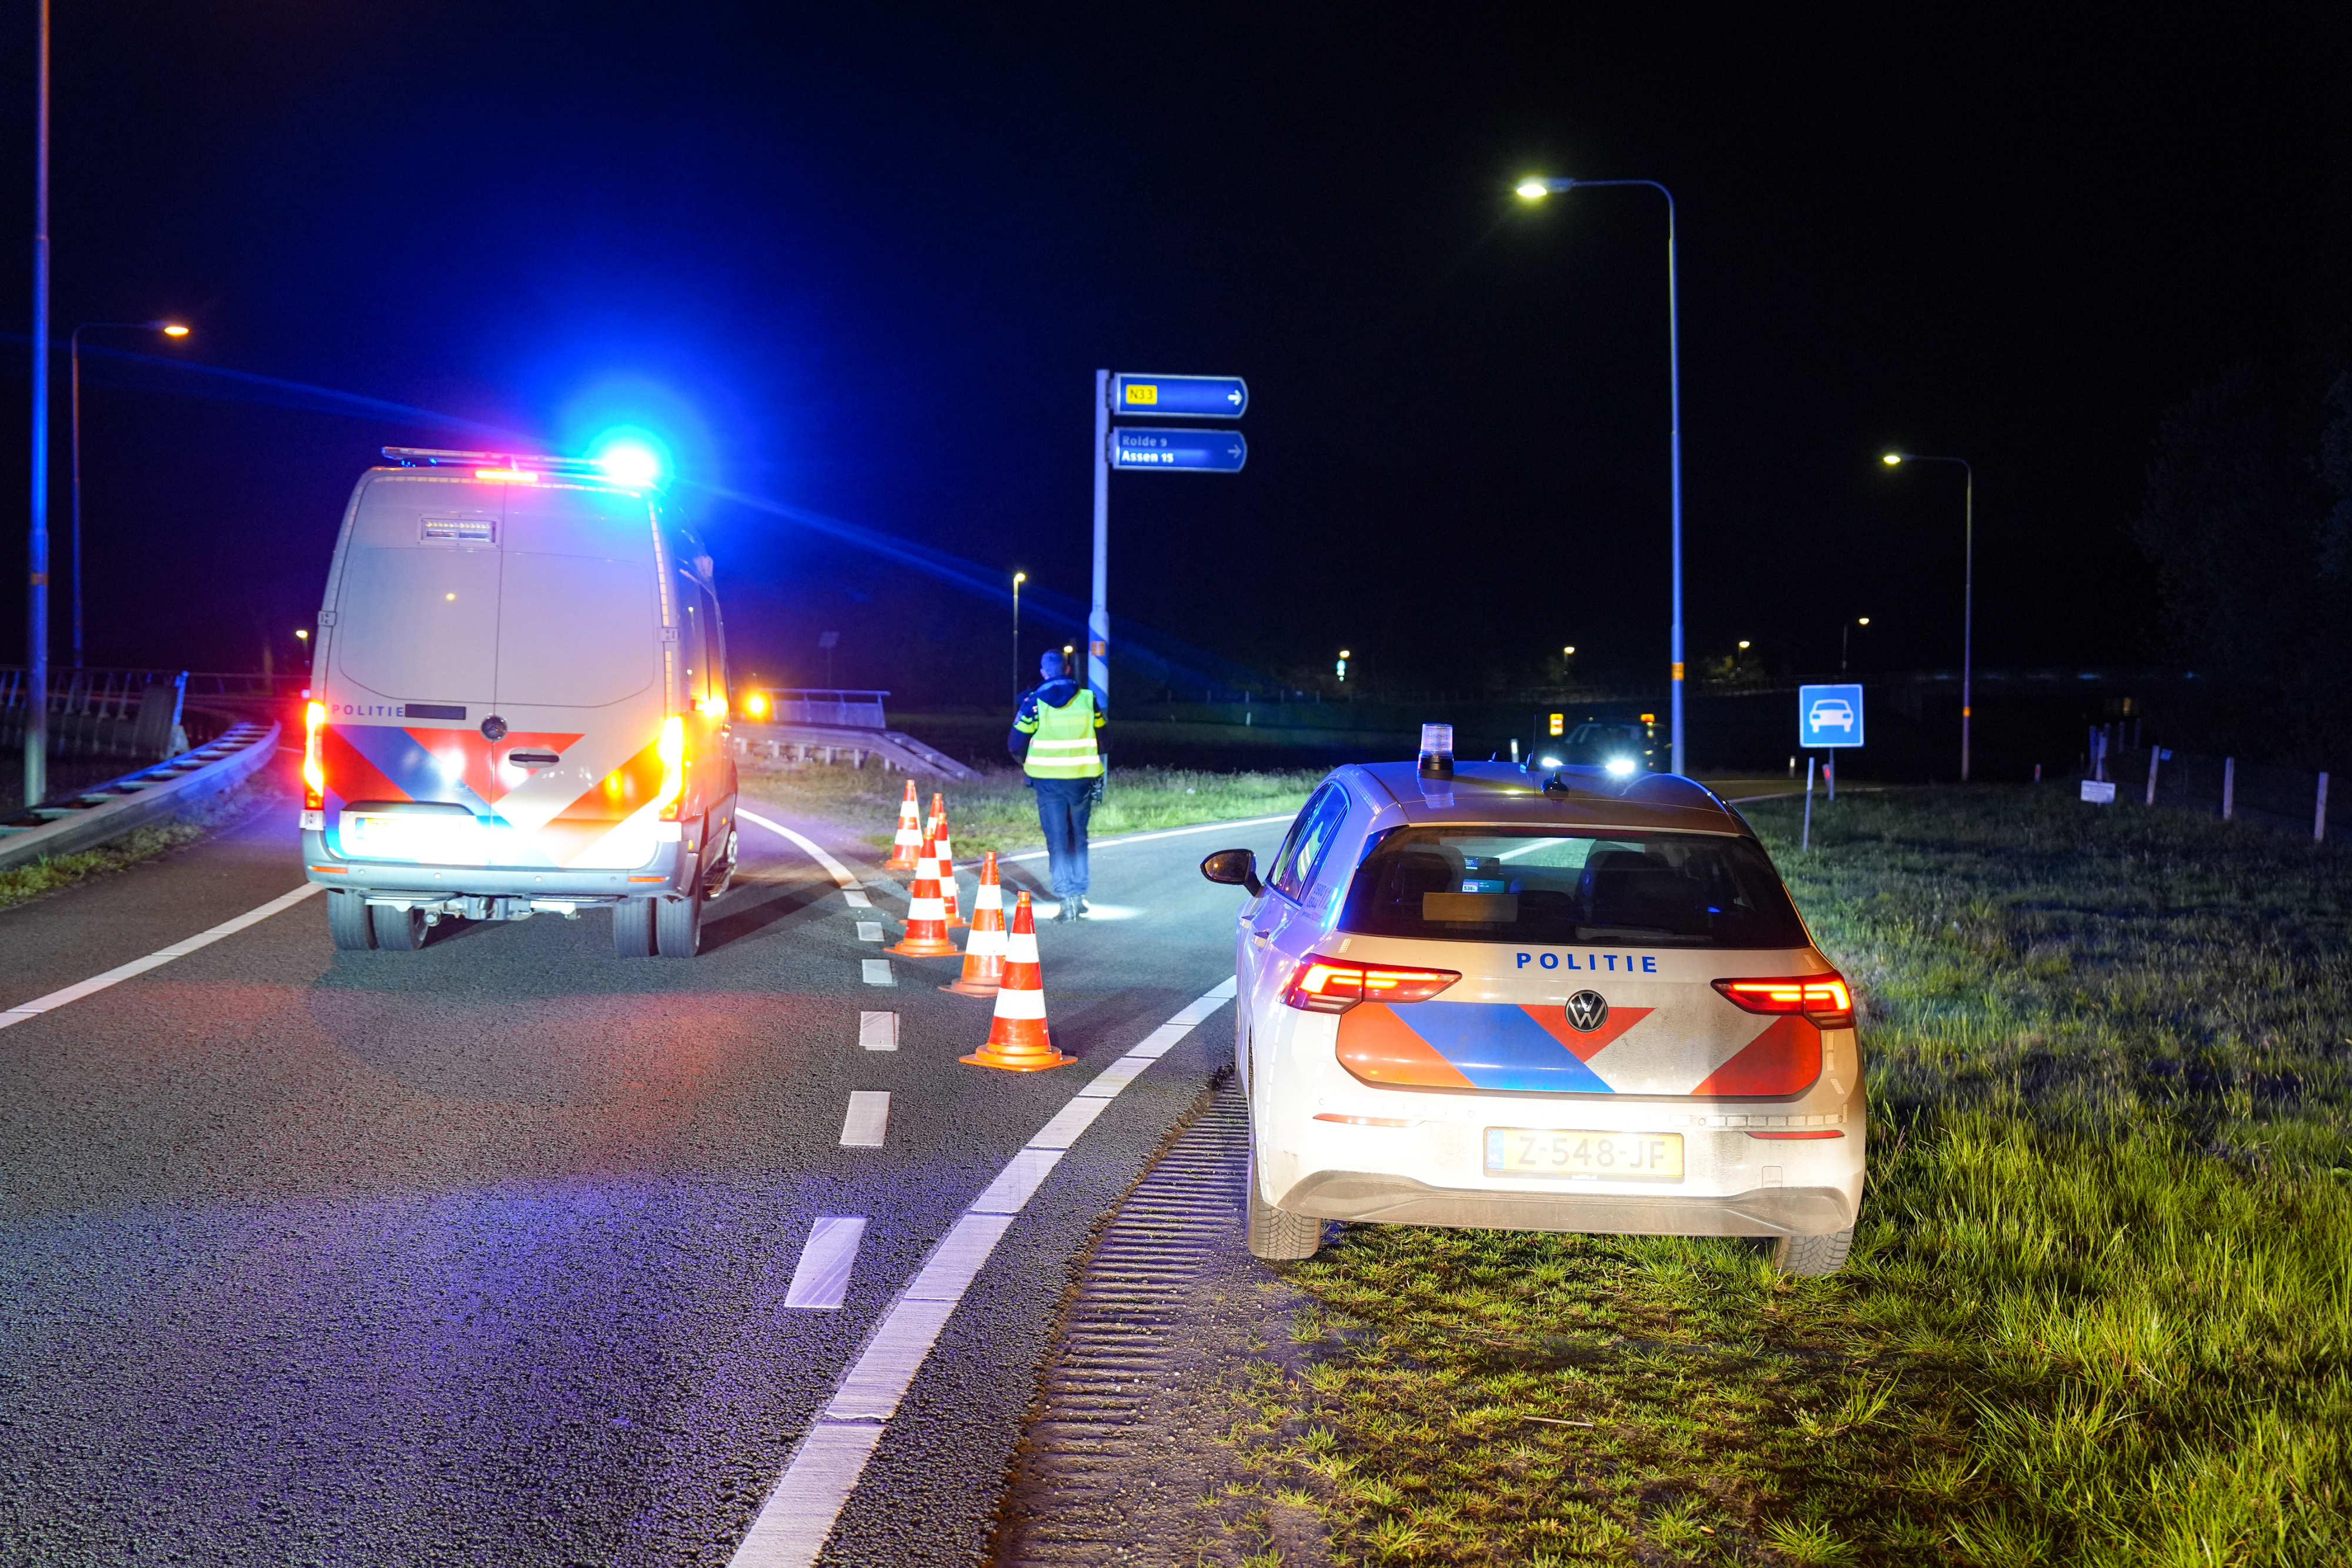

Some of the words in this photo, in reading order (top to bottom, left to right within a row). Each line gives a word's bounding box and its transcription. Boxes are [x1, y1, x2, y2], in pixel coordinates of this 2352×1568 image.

[1130, 389, 1153, 399] N33
[1122, 435, 1157, 447] Rolde
[1160, 437, 1167, 447] 9
[1121, 450, 1159, 462] Assen
[1161, 453, 1174, 463] 15
[332, 704, 404, 717] POLITIE
[1516, 952, 1657, 973] POLITIE
[1489, 1153, 1502, 1163] NL
[1518, 1136, 1665, 1169] Z-548-JF
